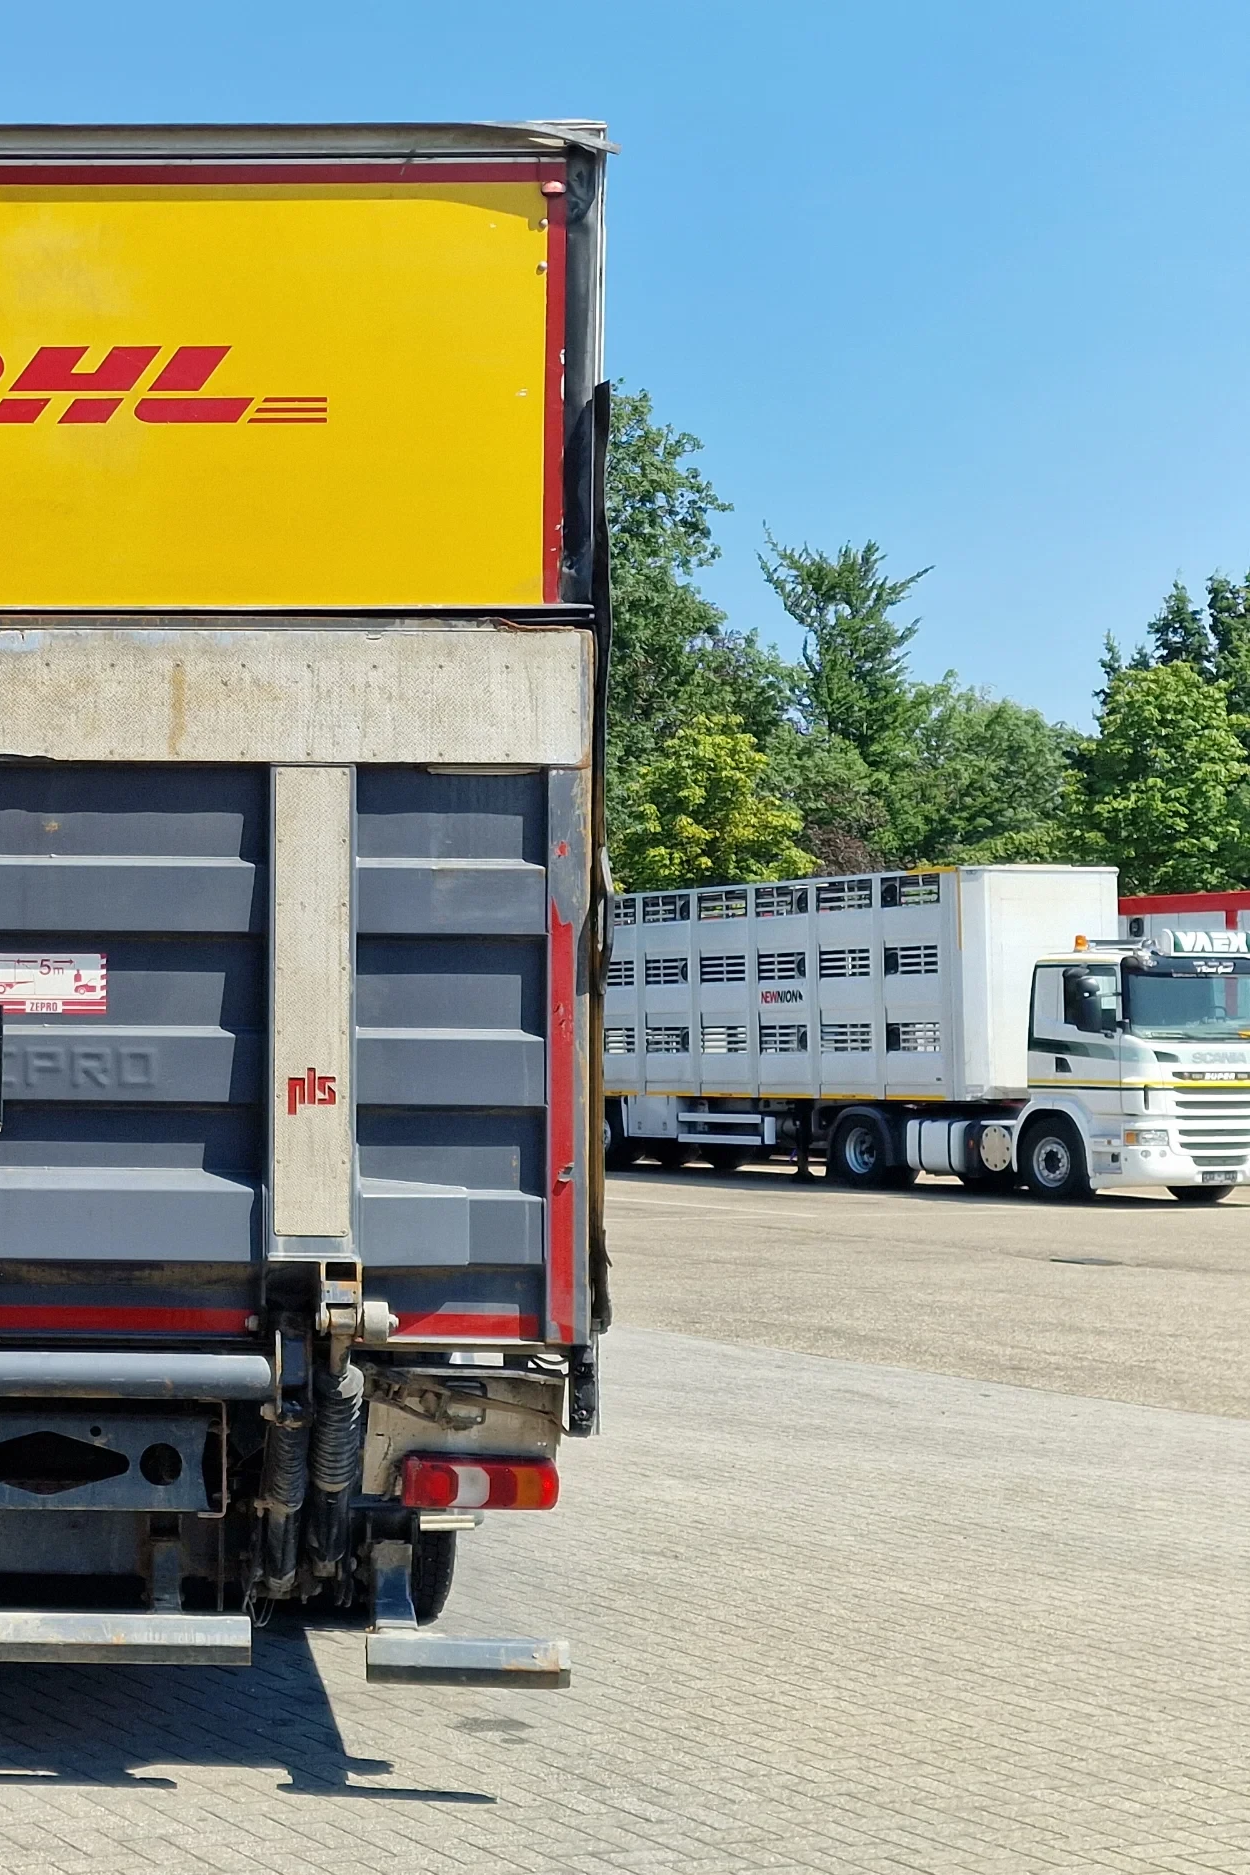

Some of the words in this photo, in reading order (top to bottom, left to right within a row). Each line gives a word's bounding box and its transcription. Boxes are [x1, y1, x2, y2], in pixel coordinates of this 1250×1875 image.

[1174, 931, 1248, 953] VAEX
[29, 1001, 58, 1013] ZEPRO
[1191, 1051, 1247, 1064] SCANIA
